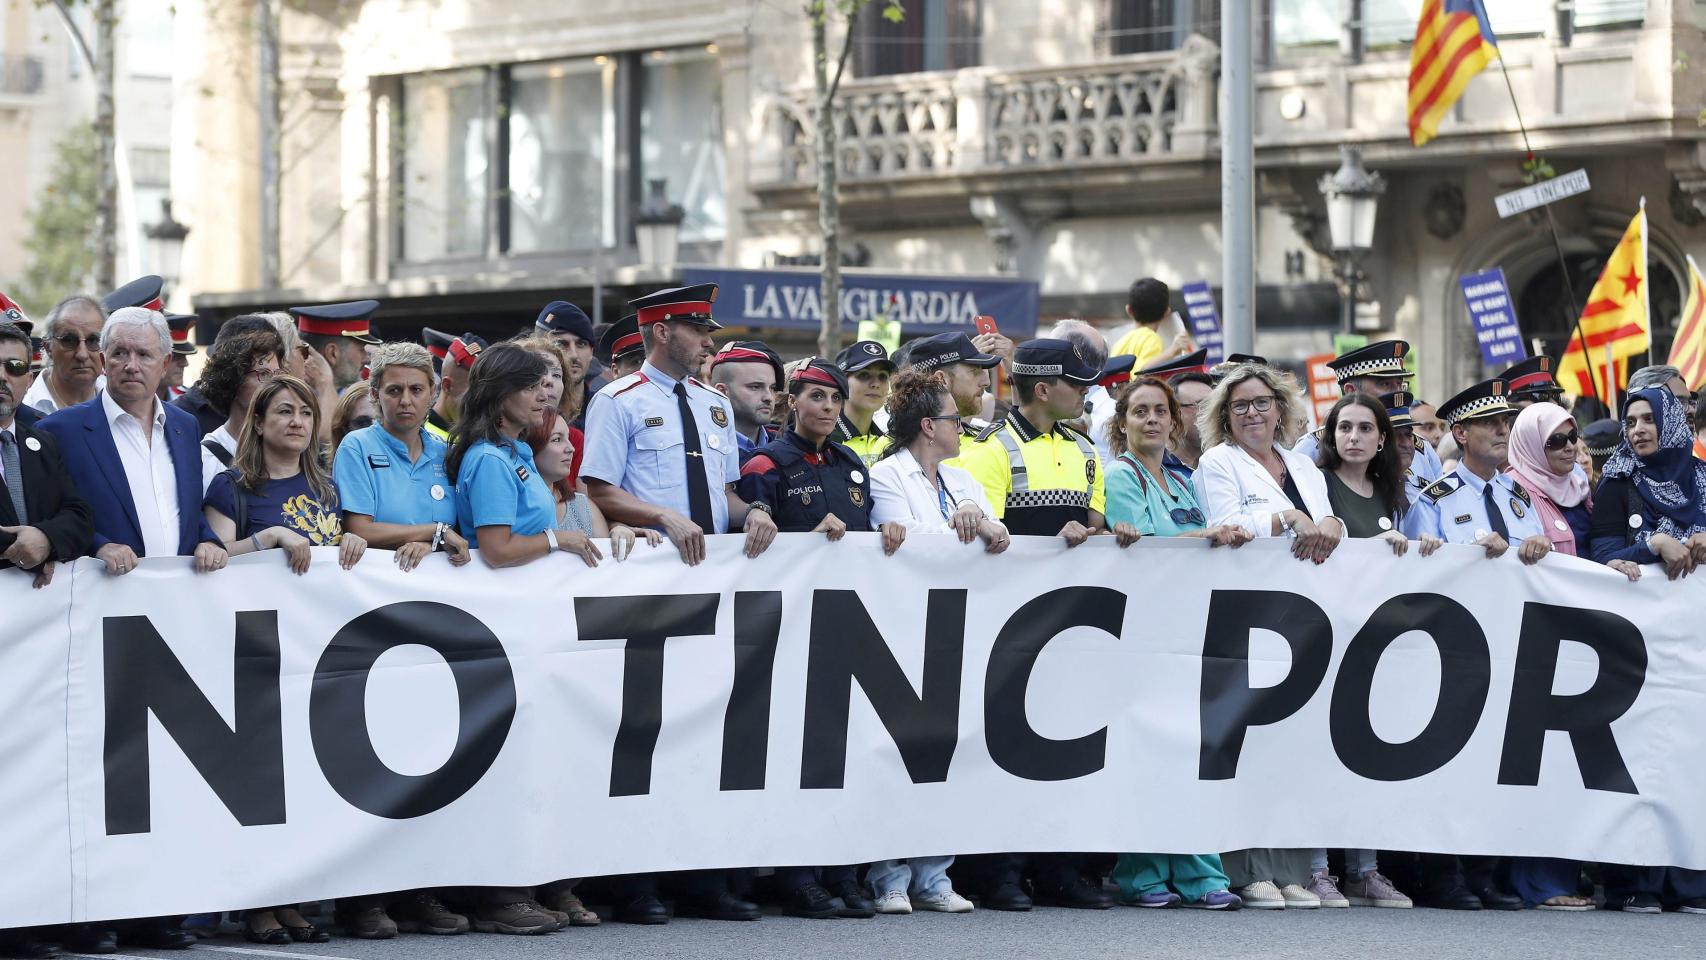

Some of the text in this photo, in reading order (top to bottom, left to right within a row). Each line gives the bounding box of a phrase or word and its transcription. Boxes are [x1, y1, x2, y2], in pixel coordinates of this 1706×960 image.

[1505, 196, 1524, 211] NO
[743, 284, 782, 318] LA
[1478, 329, 1495, 344] NOT
[787, 485, 823, 496] POLICIA
[103, 586, 1649, 835] NO TINC POR
